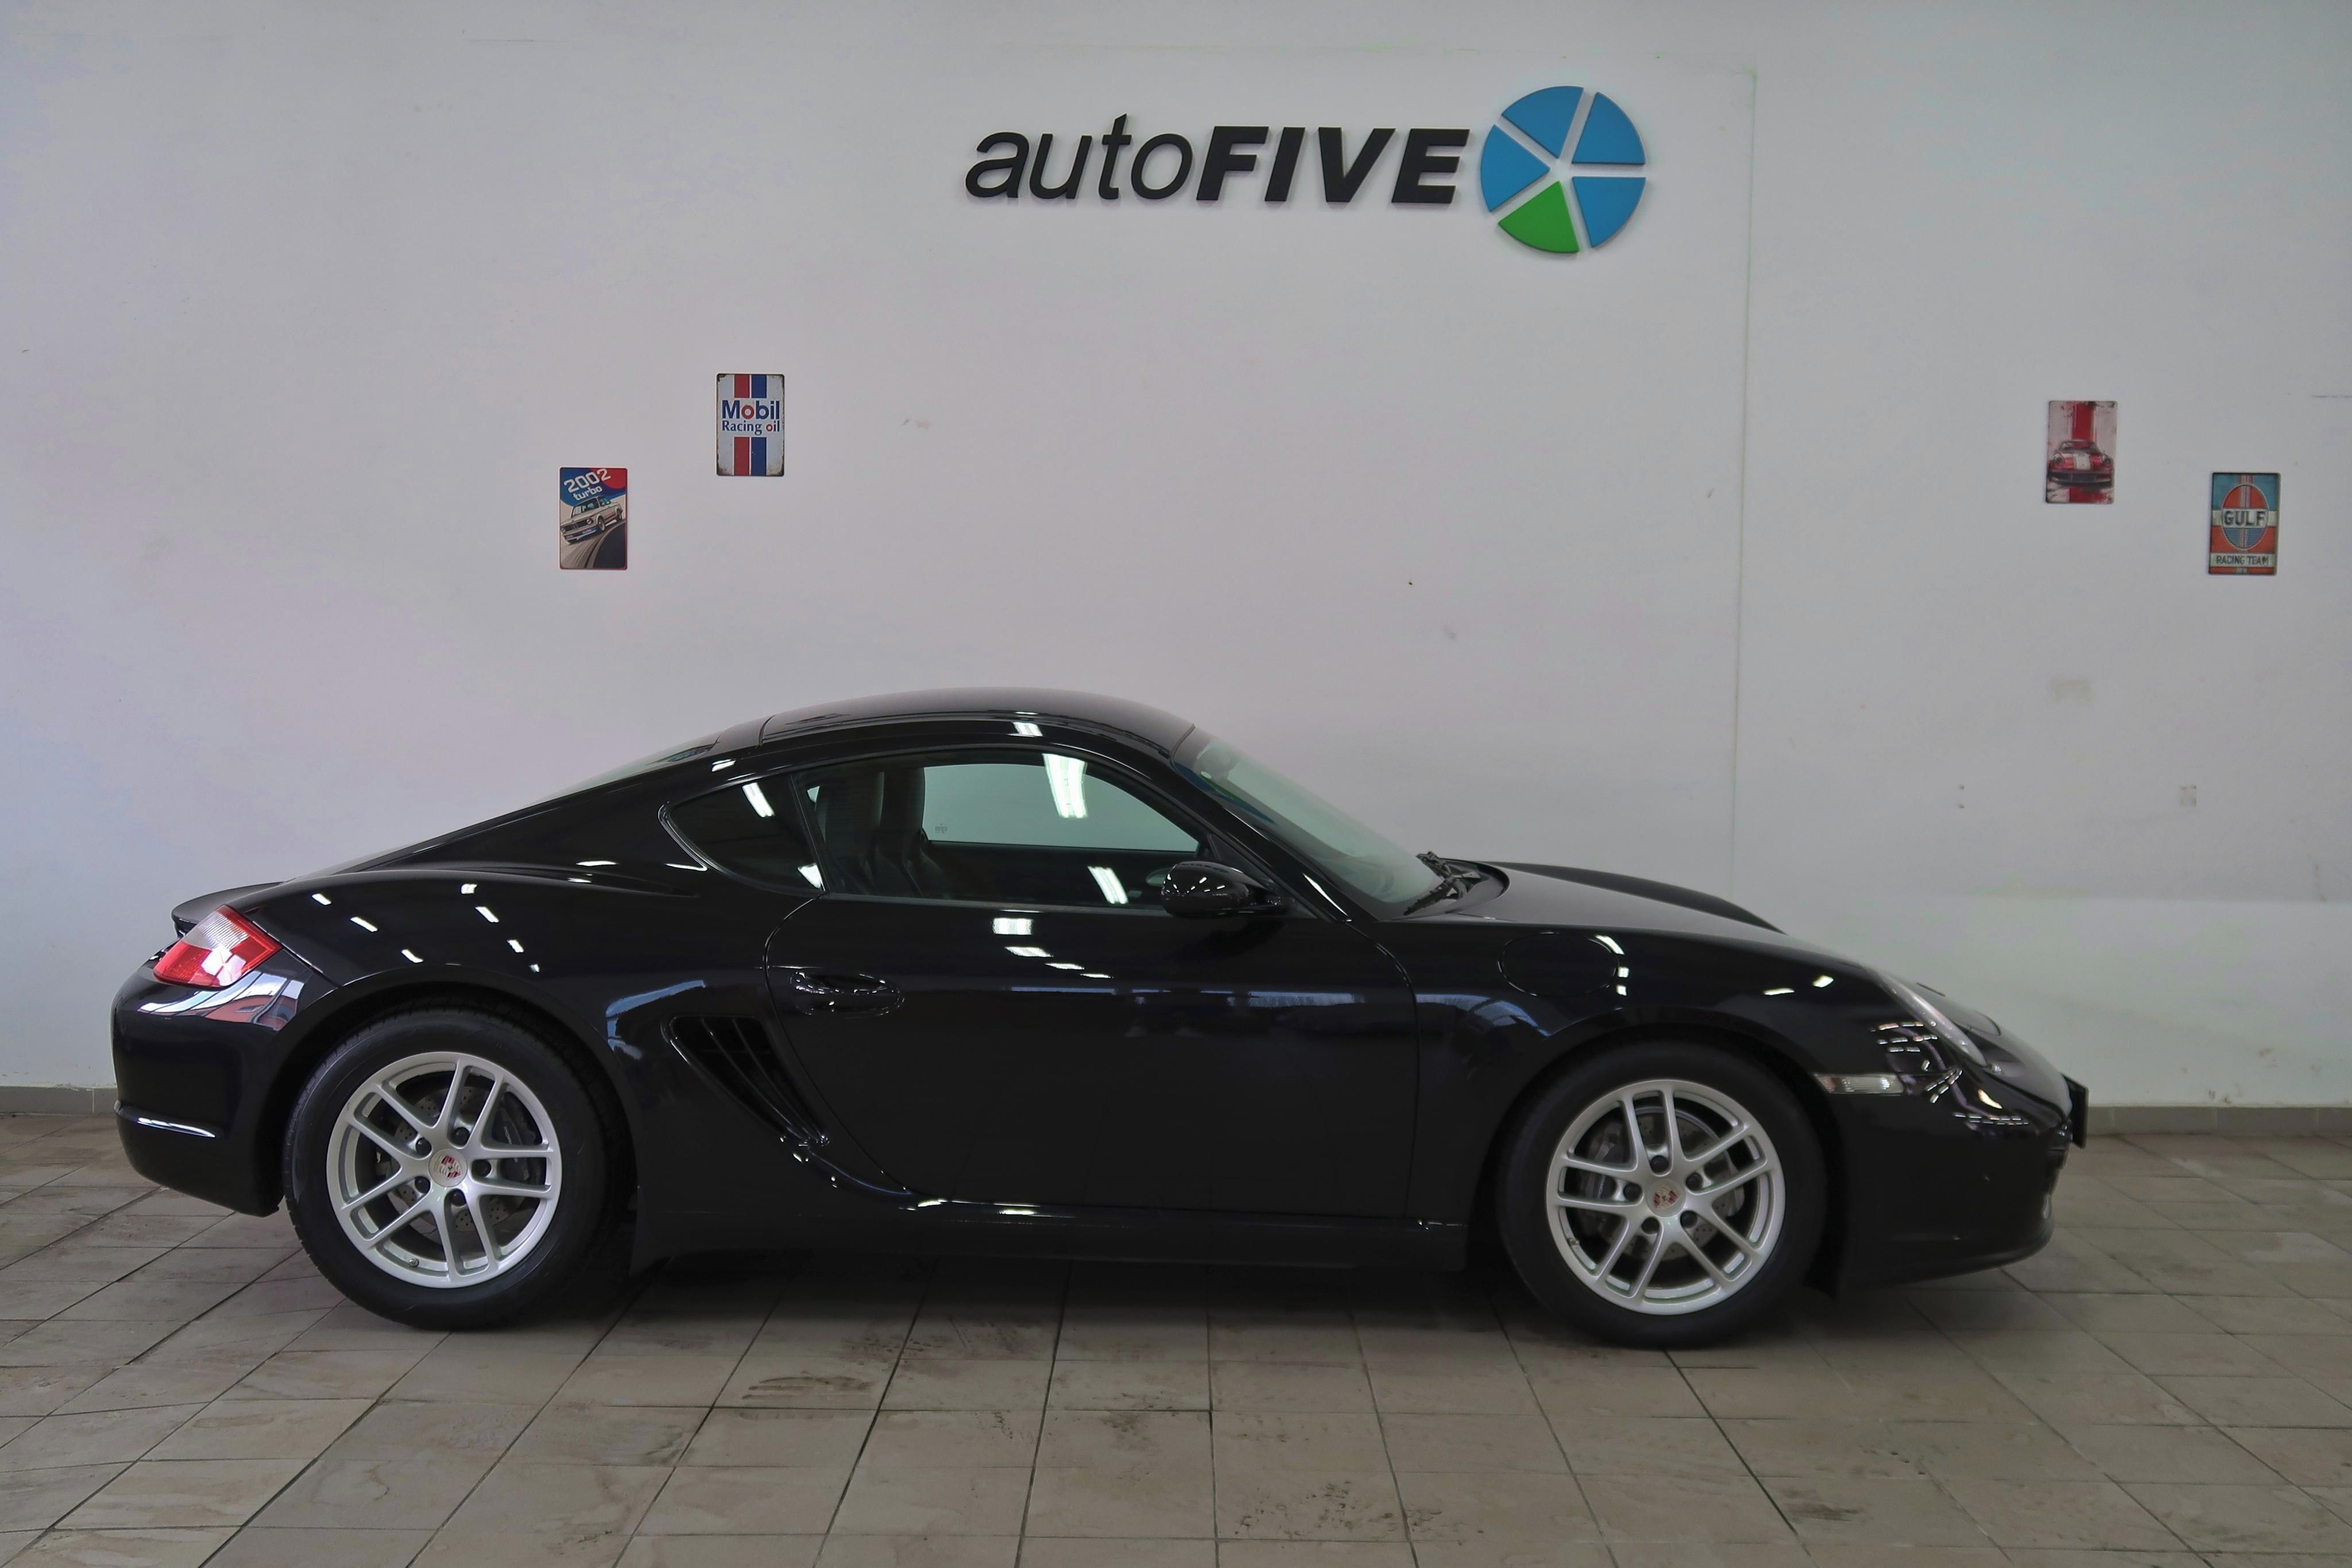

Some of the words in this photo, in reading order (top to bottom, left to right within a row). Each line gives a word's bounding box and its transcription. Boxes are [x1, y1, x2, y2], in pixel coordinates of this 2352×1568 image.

[965, 113, 1470, 206] autoFIVE
[722, 400, 780, 420] Mobil
[722, 420, 763, 436] Racing
[766, 420, 780, 432] oil
[563, 468, 611, 493] 2002
[573, 486, 602, 501] turbo
[2224, 510, 2266, 526] GULF
[2216, 555, 2245, 565] RACING
[2247, 556, 2269, 565] TEAM
